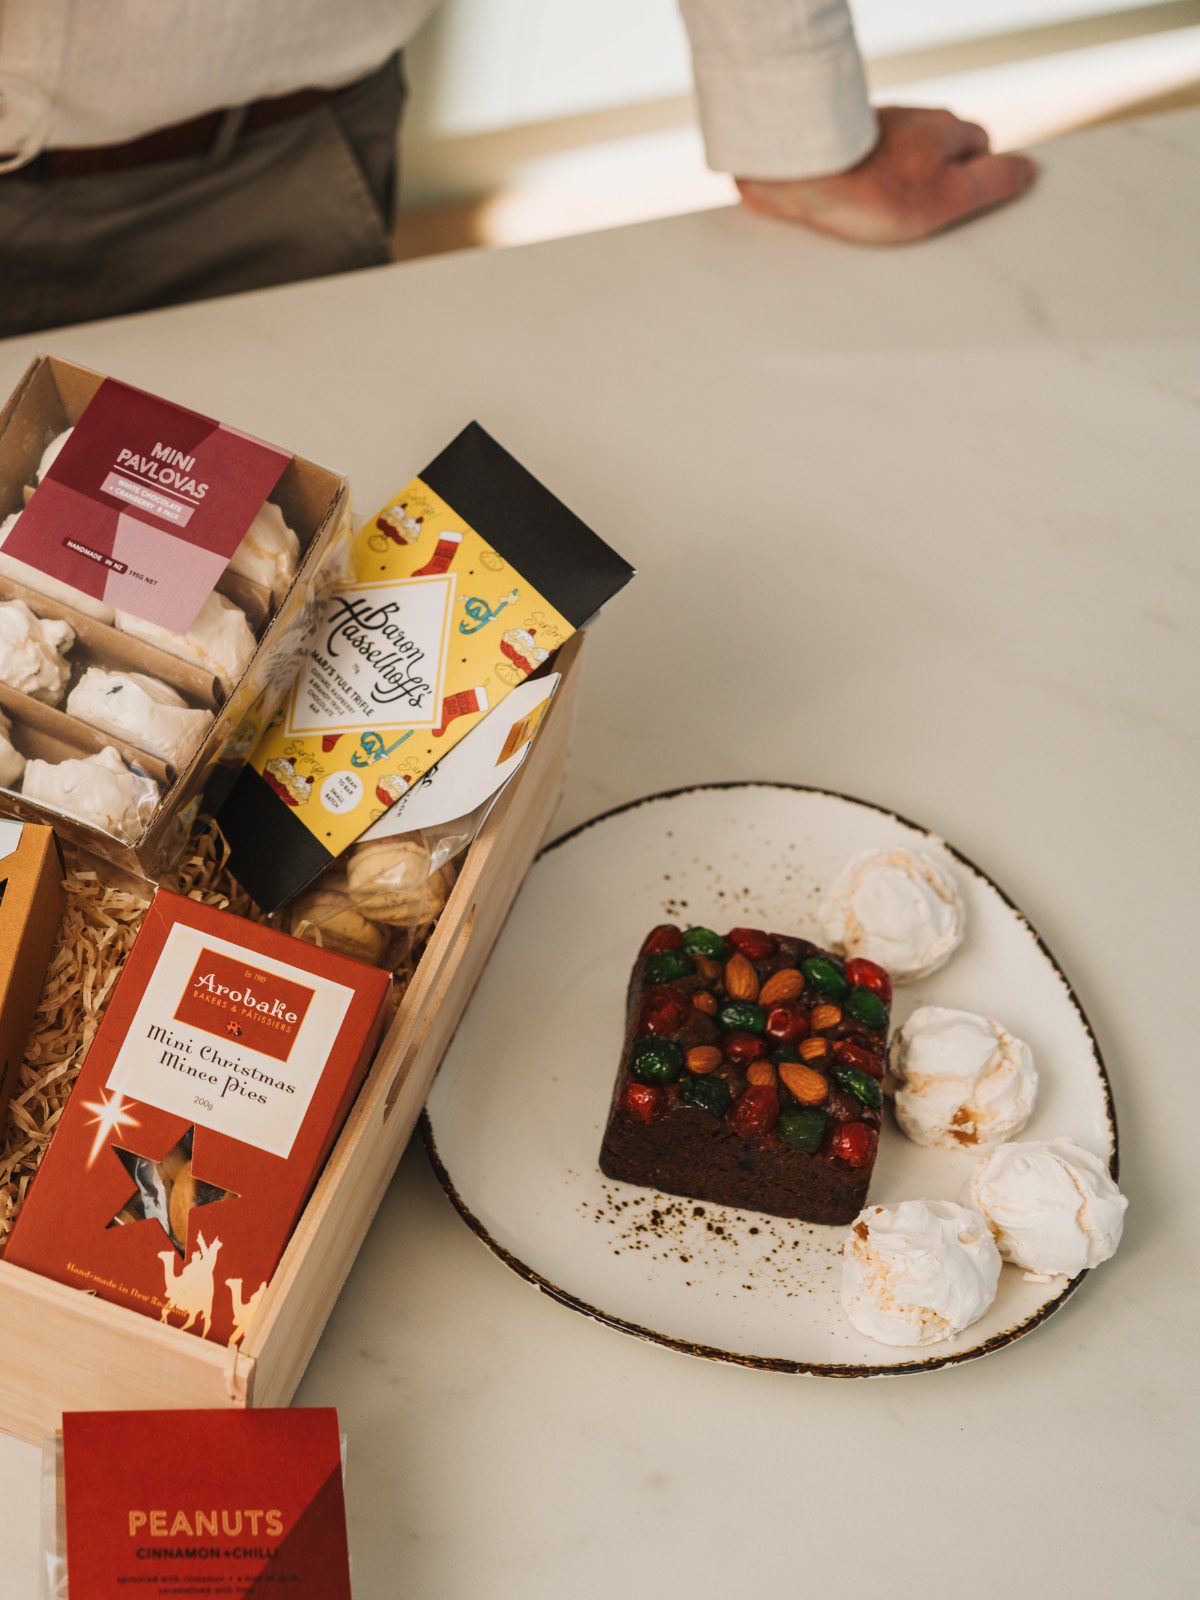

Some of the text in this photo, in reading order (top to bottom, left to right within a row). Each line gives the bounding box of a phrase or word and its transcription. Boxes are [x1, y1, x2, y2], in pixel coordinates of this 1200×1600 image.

[116, 448, 209, 499] PAVLOVAS
[150, 442, 196, 472] MINI
[66, 540, 103, 561] HANDMADE
[113, 562, 124, 571] NZ
[145, 577, 158, 586] NET
[357, 602, 425, 662] Baron
[332, 673, 352, 694] YULE
[349, 691, 374, 717] TRIFLE
[193, 990, 228, 1009] BAKERS
[194, 973, 298, 1024] Arobake
[146, 1024, 296, 1094] Mini Christmas
[159, 1050, 268, 1105] Mince Pies
[193, 1095, 214, 1111] 200g
[66, 1262, 117, 1289] Hand-made
[118, 1283, 128, 1294] in
[128, 1510, 284, 1537] PEANUTS
